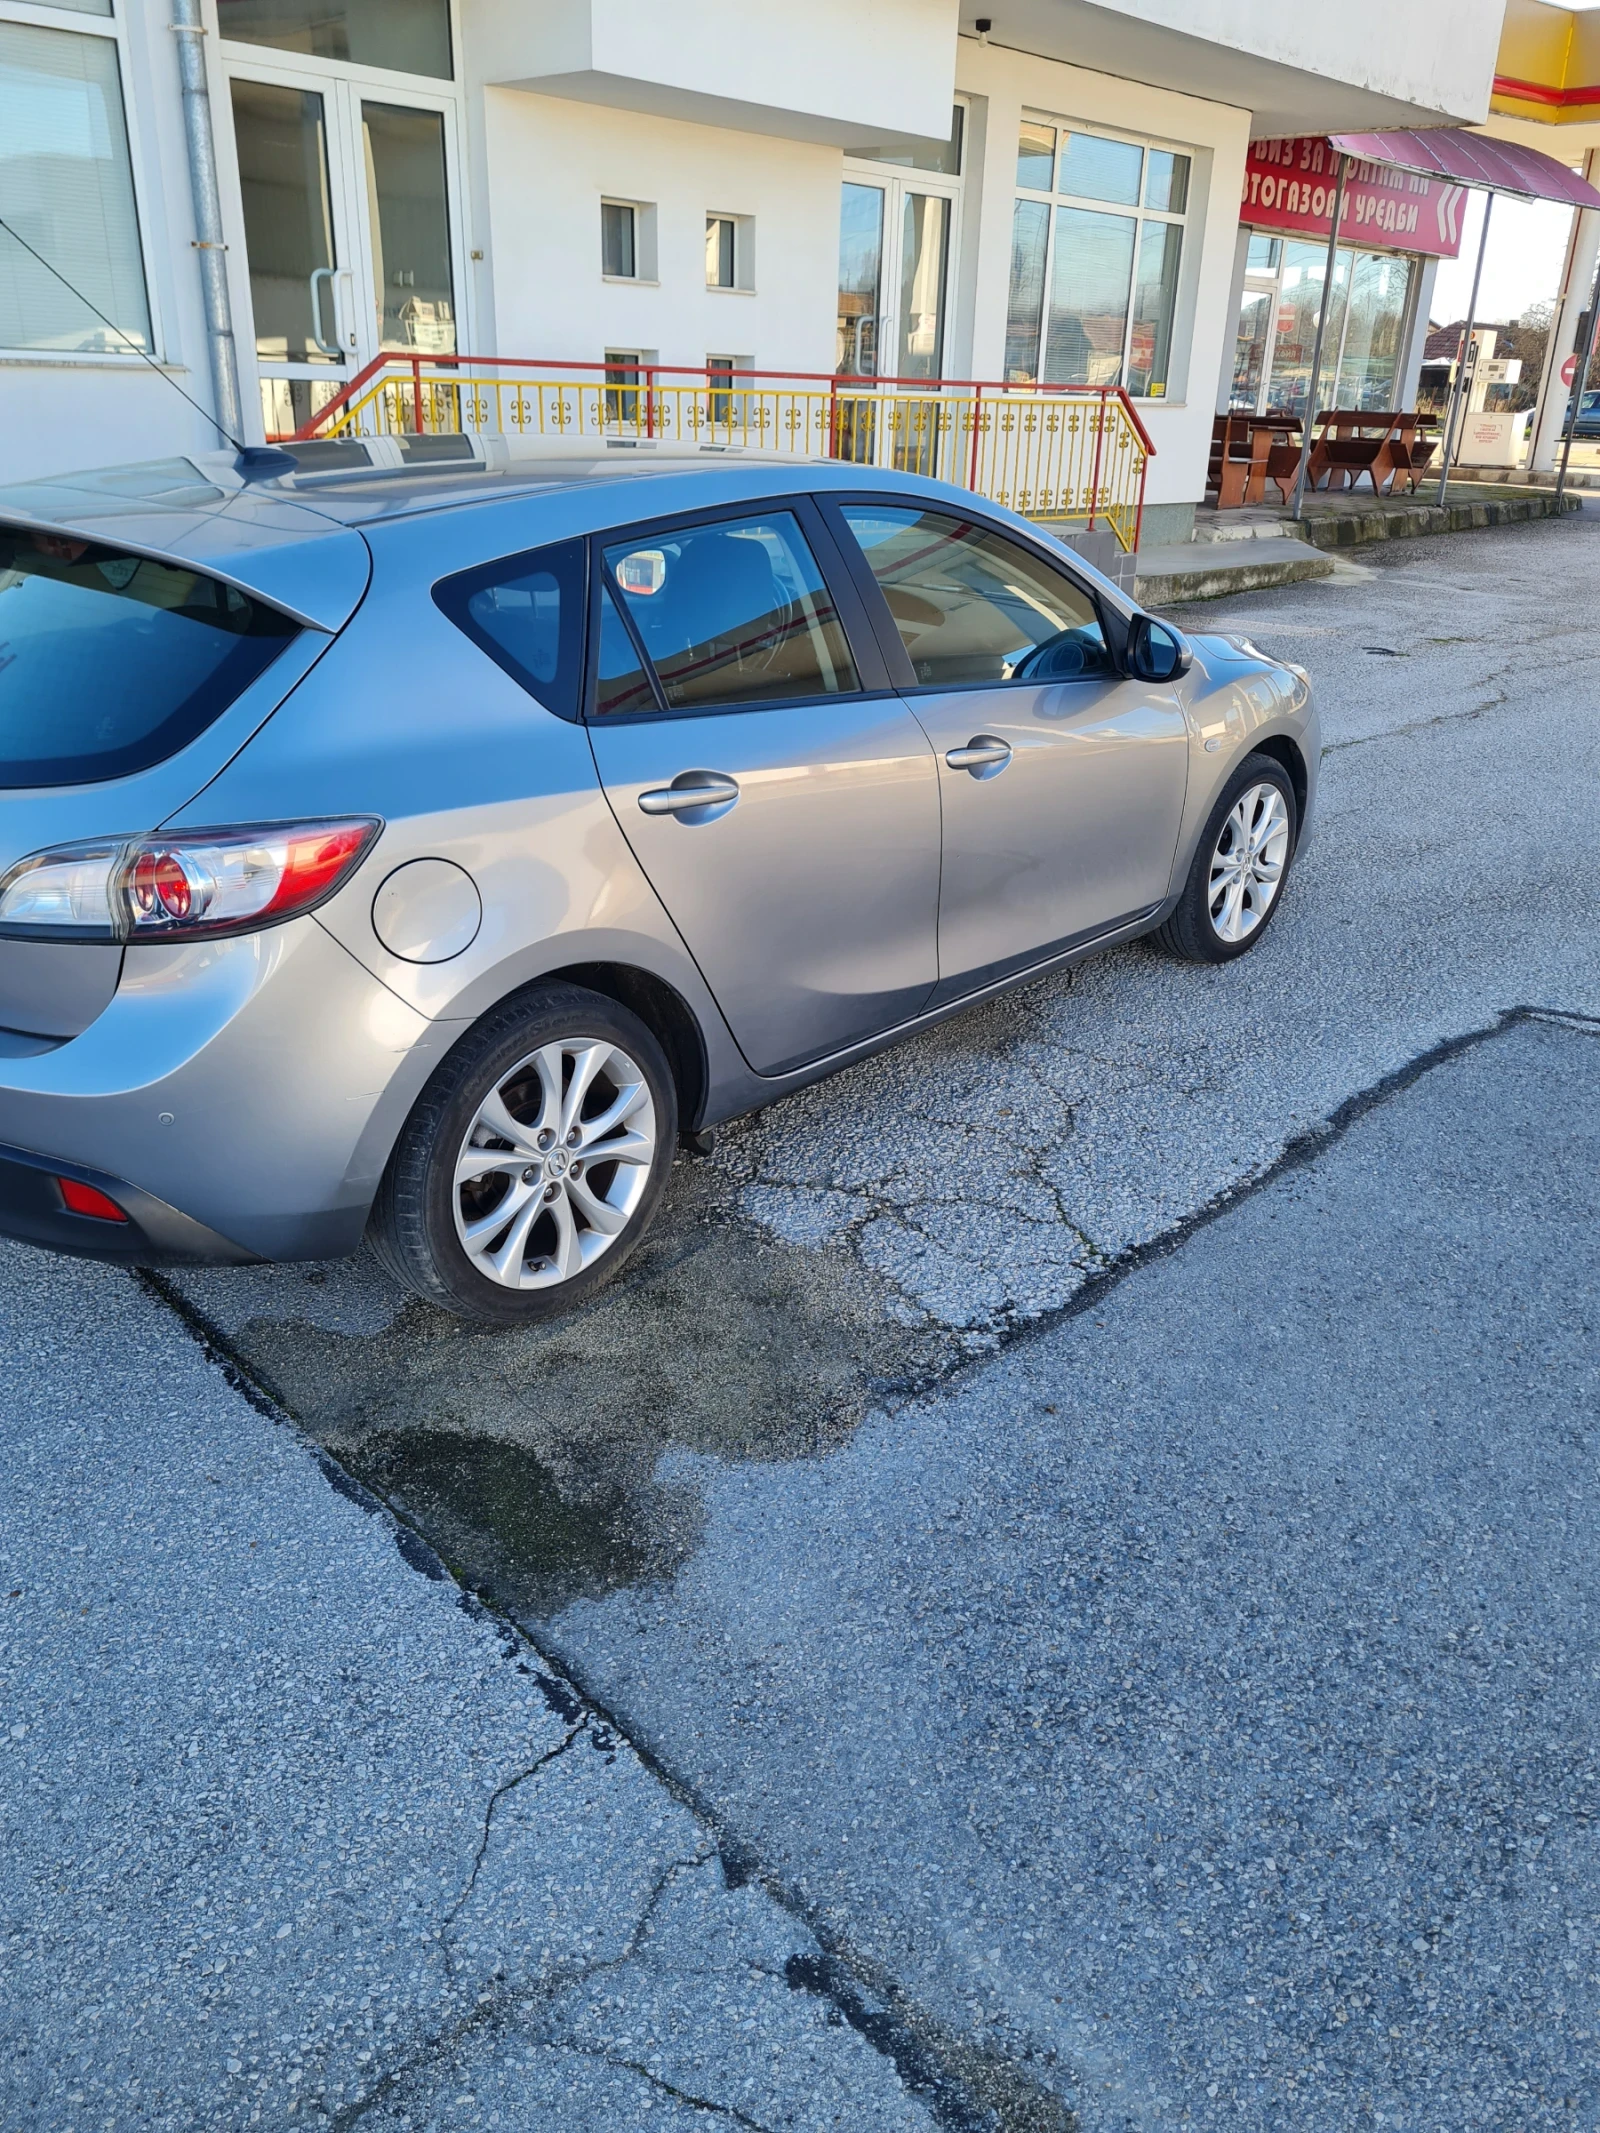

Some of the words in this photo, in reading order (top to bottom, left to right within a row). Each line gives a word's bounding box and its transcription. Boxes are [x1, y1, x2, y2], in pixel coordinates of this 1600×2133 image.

[1300, 139, 1325, 173] ЗА
[1241, 171, 1350, 221] ВТОГАЗОВИ
[1355, 194, 1419, 233] УРЕДБИ
